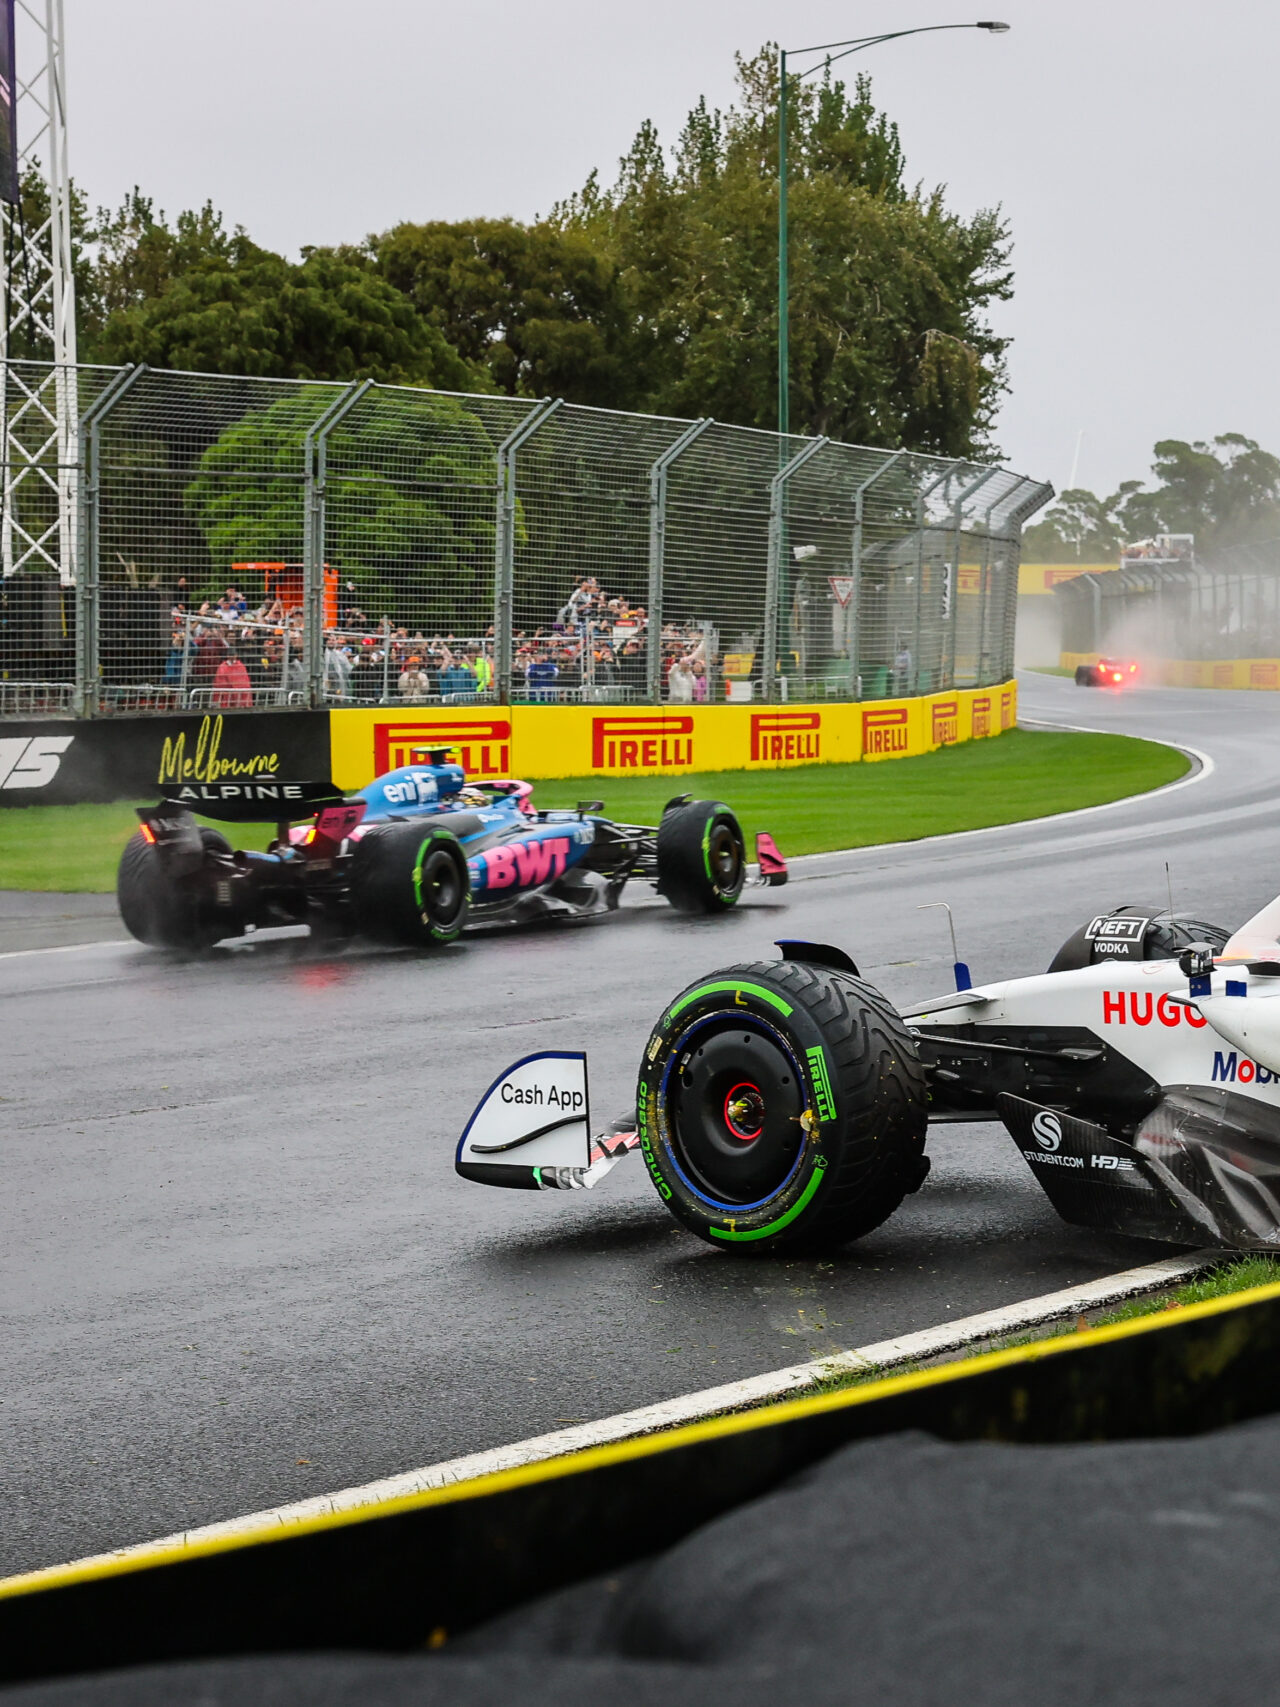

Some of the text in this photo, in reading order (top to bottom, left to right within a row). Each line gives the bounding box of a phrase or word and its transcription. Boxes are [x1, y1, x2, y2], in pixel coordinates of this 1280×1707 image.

[591, 716, 695, 769] PIRELLI
[750, 712, 821, 761] PIRELLI
[862, 708, 908, 753] PIRELLI
[158, 714, 280, 784] Melbourne
[179, 785, 303, 800] ALPINE
[383, 776, 417, 803] eni
[481, 838, 570, 889] BWT
[1092, 919, 1140, 934] NEFT
[1094, 942, 1130, 954] VODKA
[501, 1083, 583, 1111] Cash App
[806, 1045, 837, 1121] PIRELLI
[1023, 1150, 1084, 1168] STUDENT.COM
